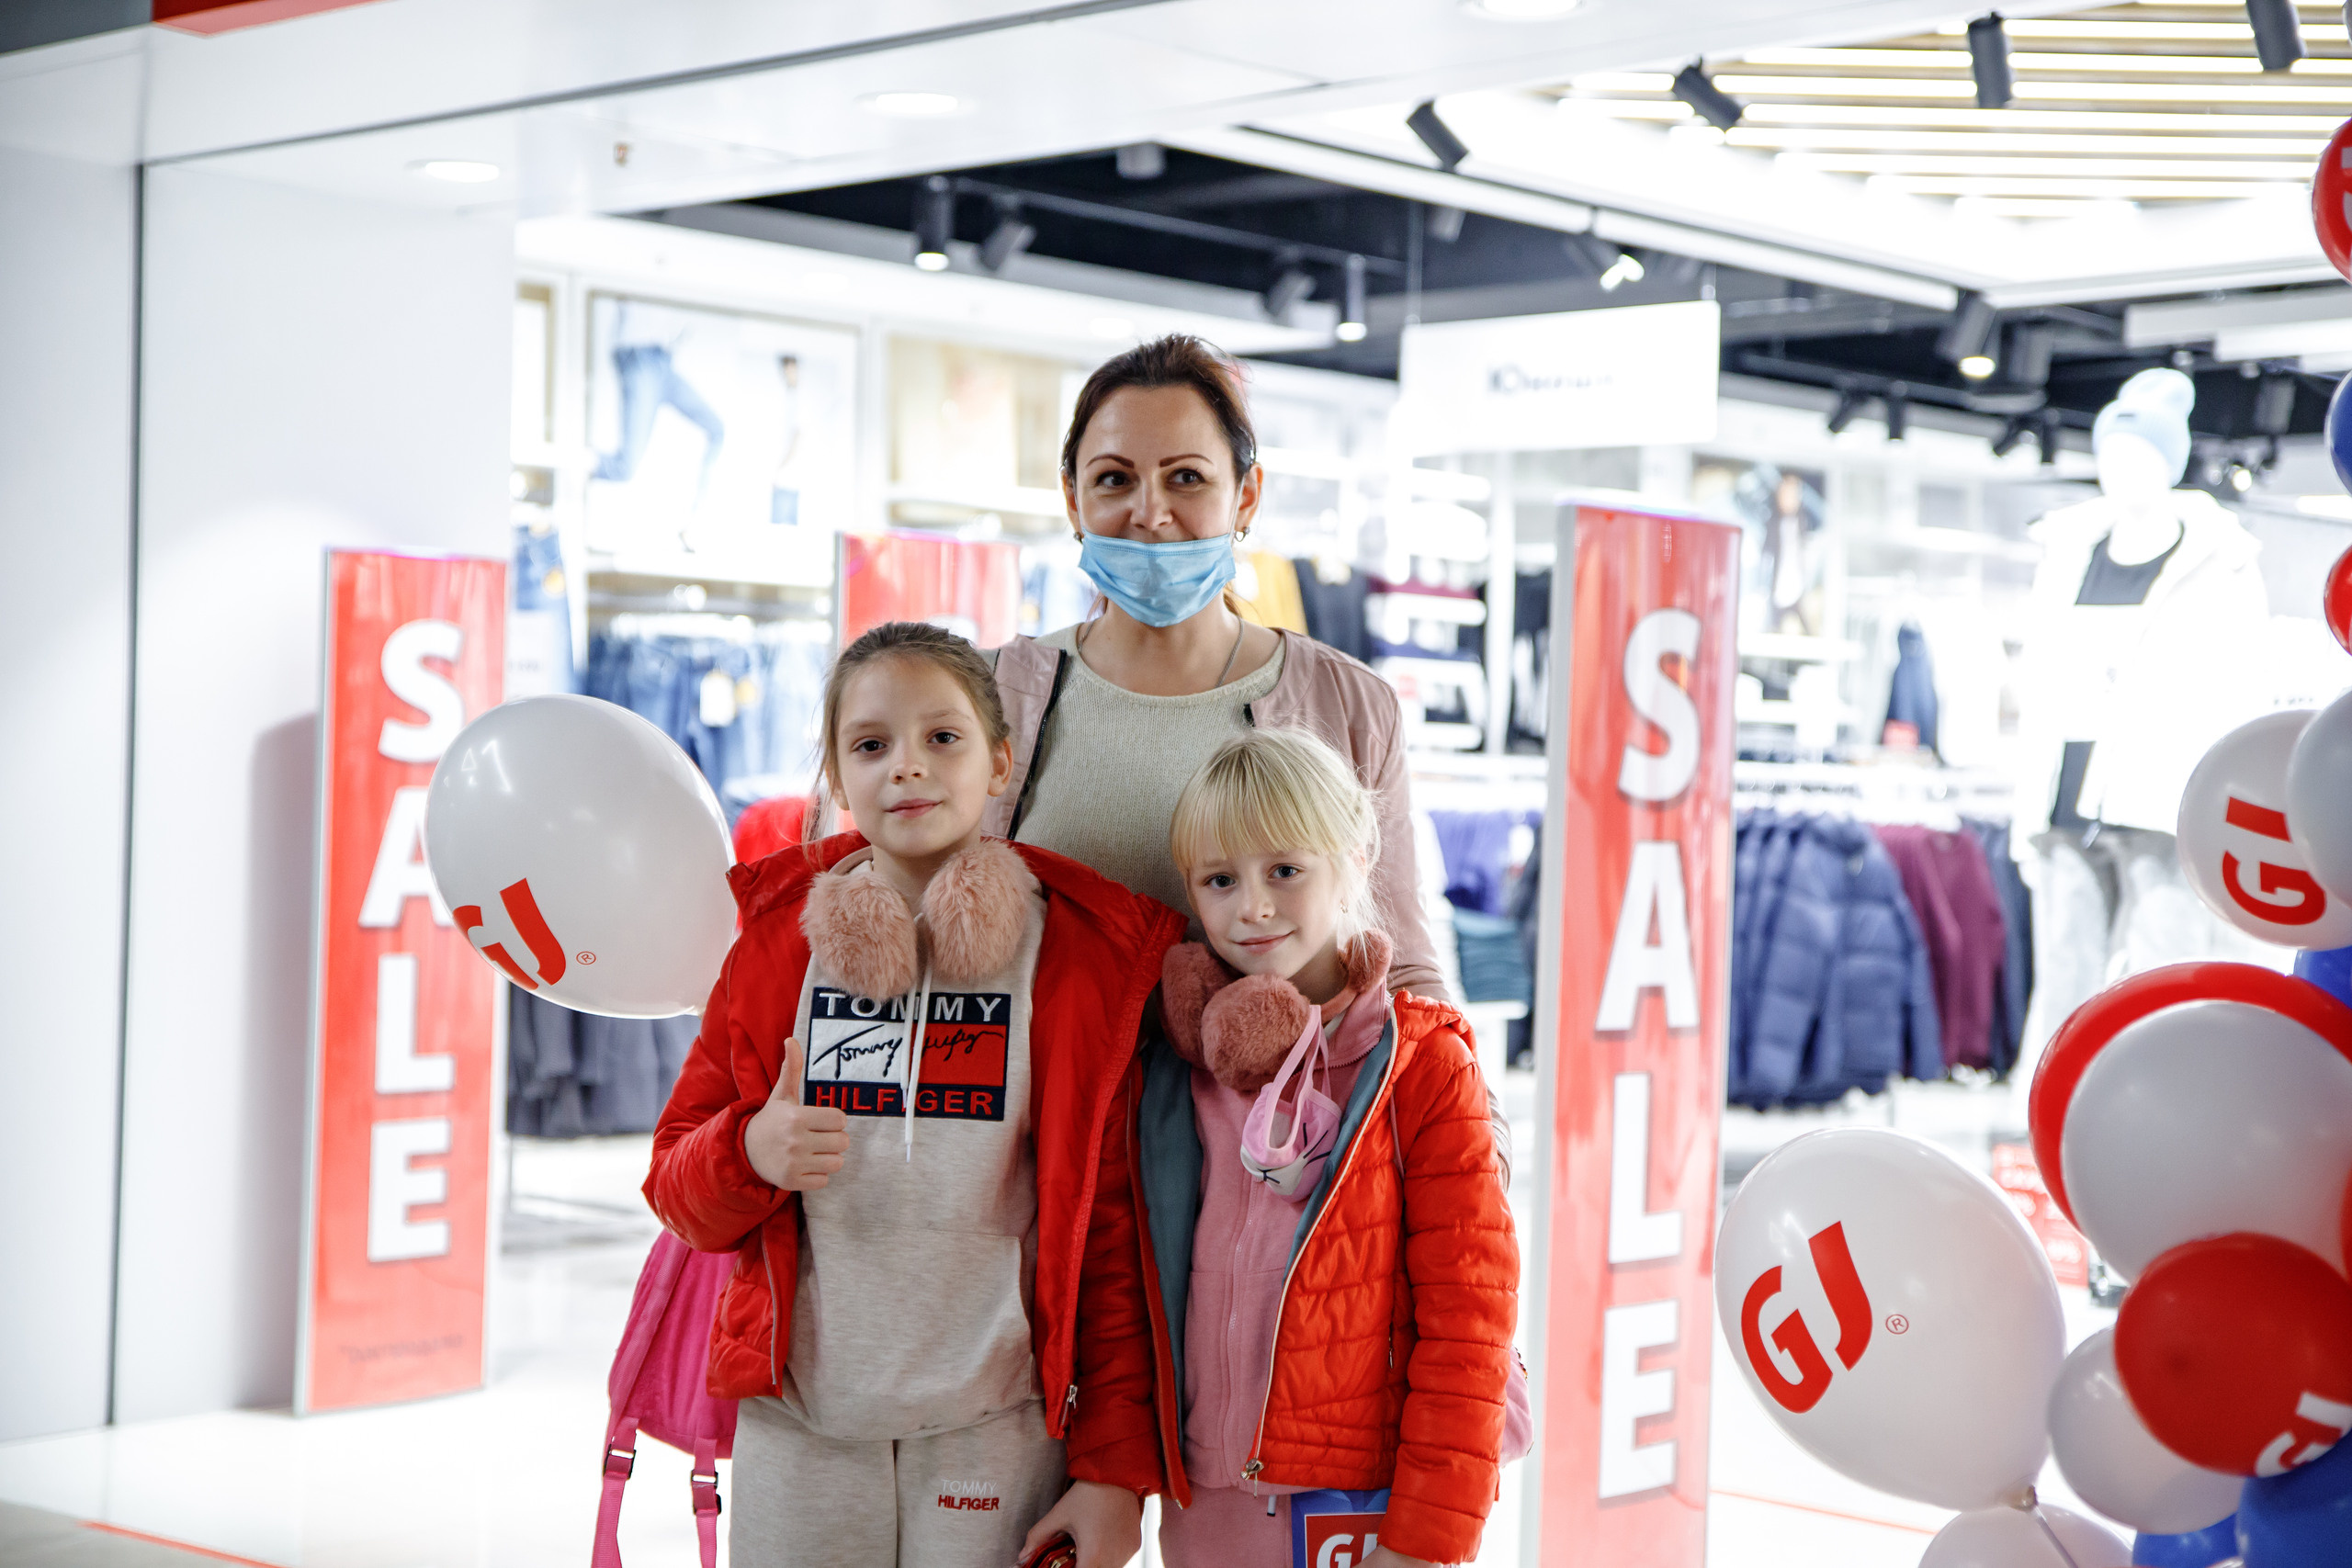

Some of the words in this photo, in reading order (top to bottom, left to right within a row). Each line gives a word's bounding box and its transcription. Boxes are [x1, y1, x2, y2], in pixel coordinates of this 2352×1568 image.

[1595, 607, 1702, 1501] SALE
[816, 1086, 993, 1115] HILFGER
[1741, 1220, 1873, 1414] GJ
[942, 1478, 997, 1495] TOMMY
[938, 1495, 1000, 1511] HILFIGER
